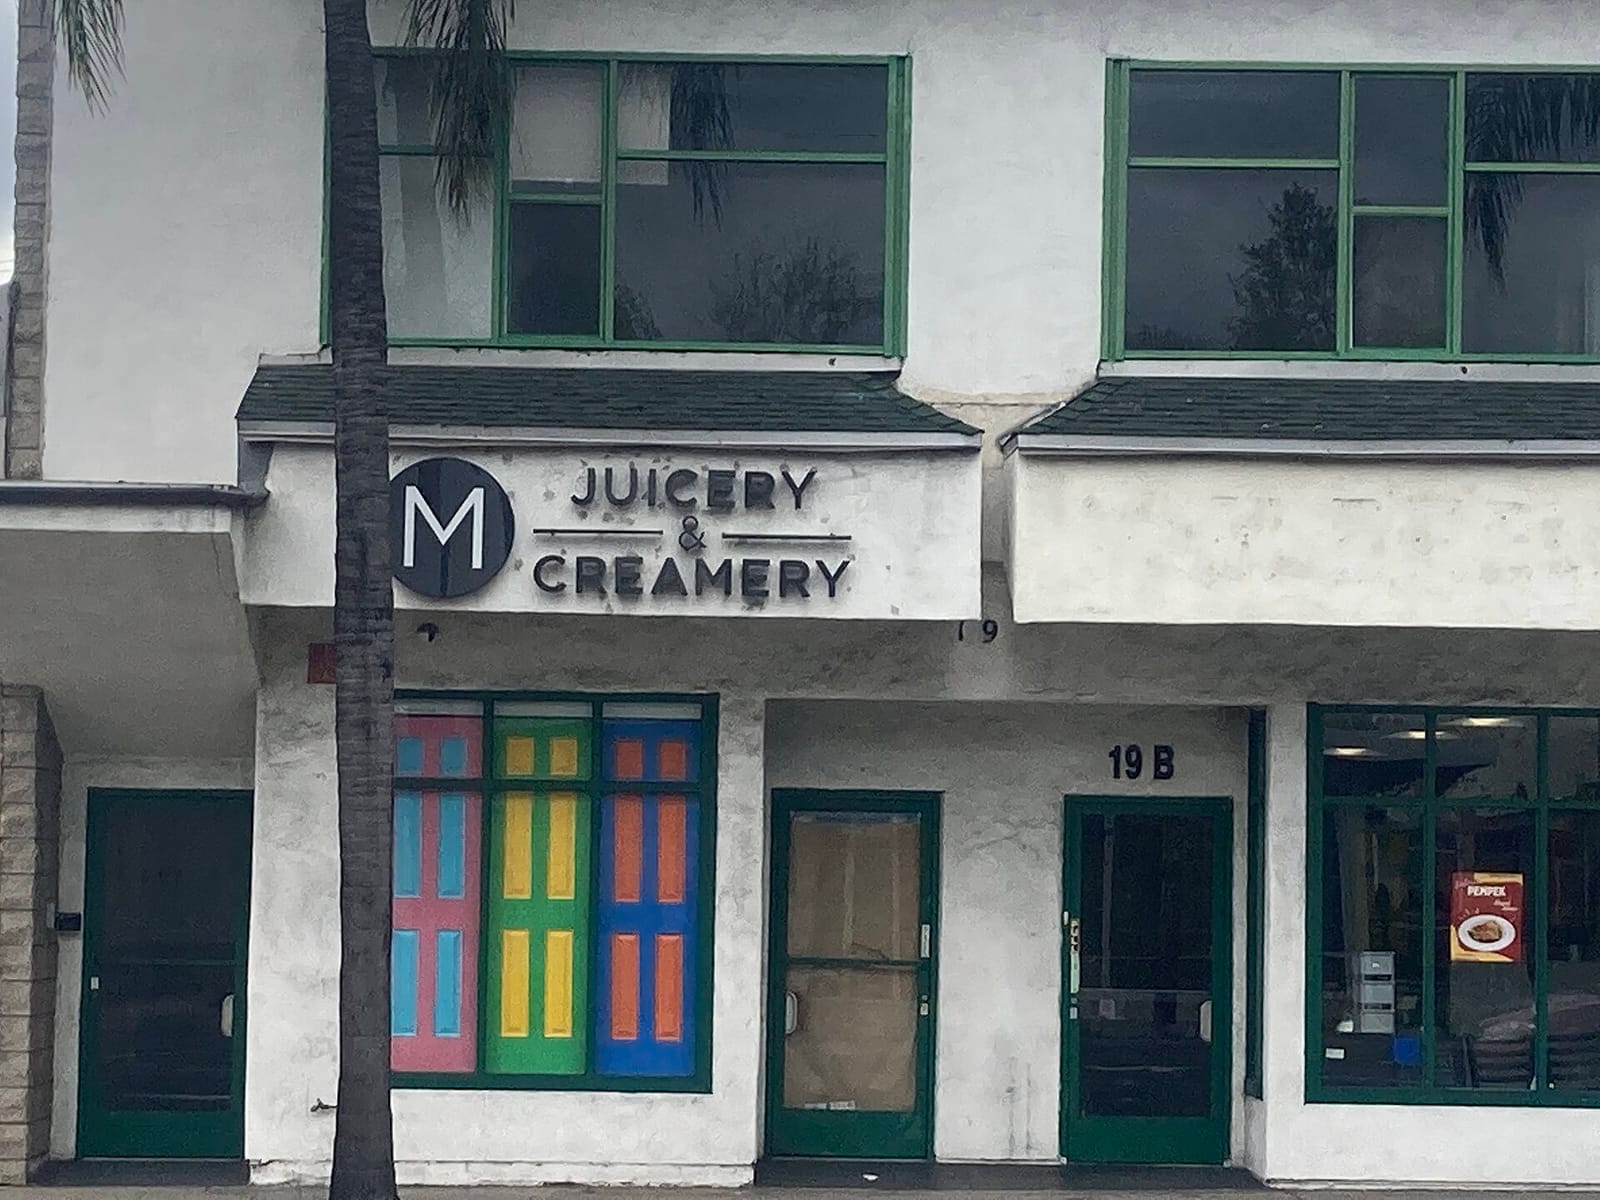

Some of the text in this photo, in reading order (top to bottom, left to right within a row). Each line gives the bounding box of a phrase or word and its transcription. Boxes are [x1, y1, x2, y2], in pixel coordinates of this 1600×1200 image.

[571, 467, 817, 510] JUICERY
[403, 485, 484, 570] M
[678, 515, 706, 553] &
[533, 554, 850, 599] CREAMERY
[1108, 744, 1174, 779] 19 B
